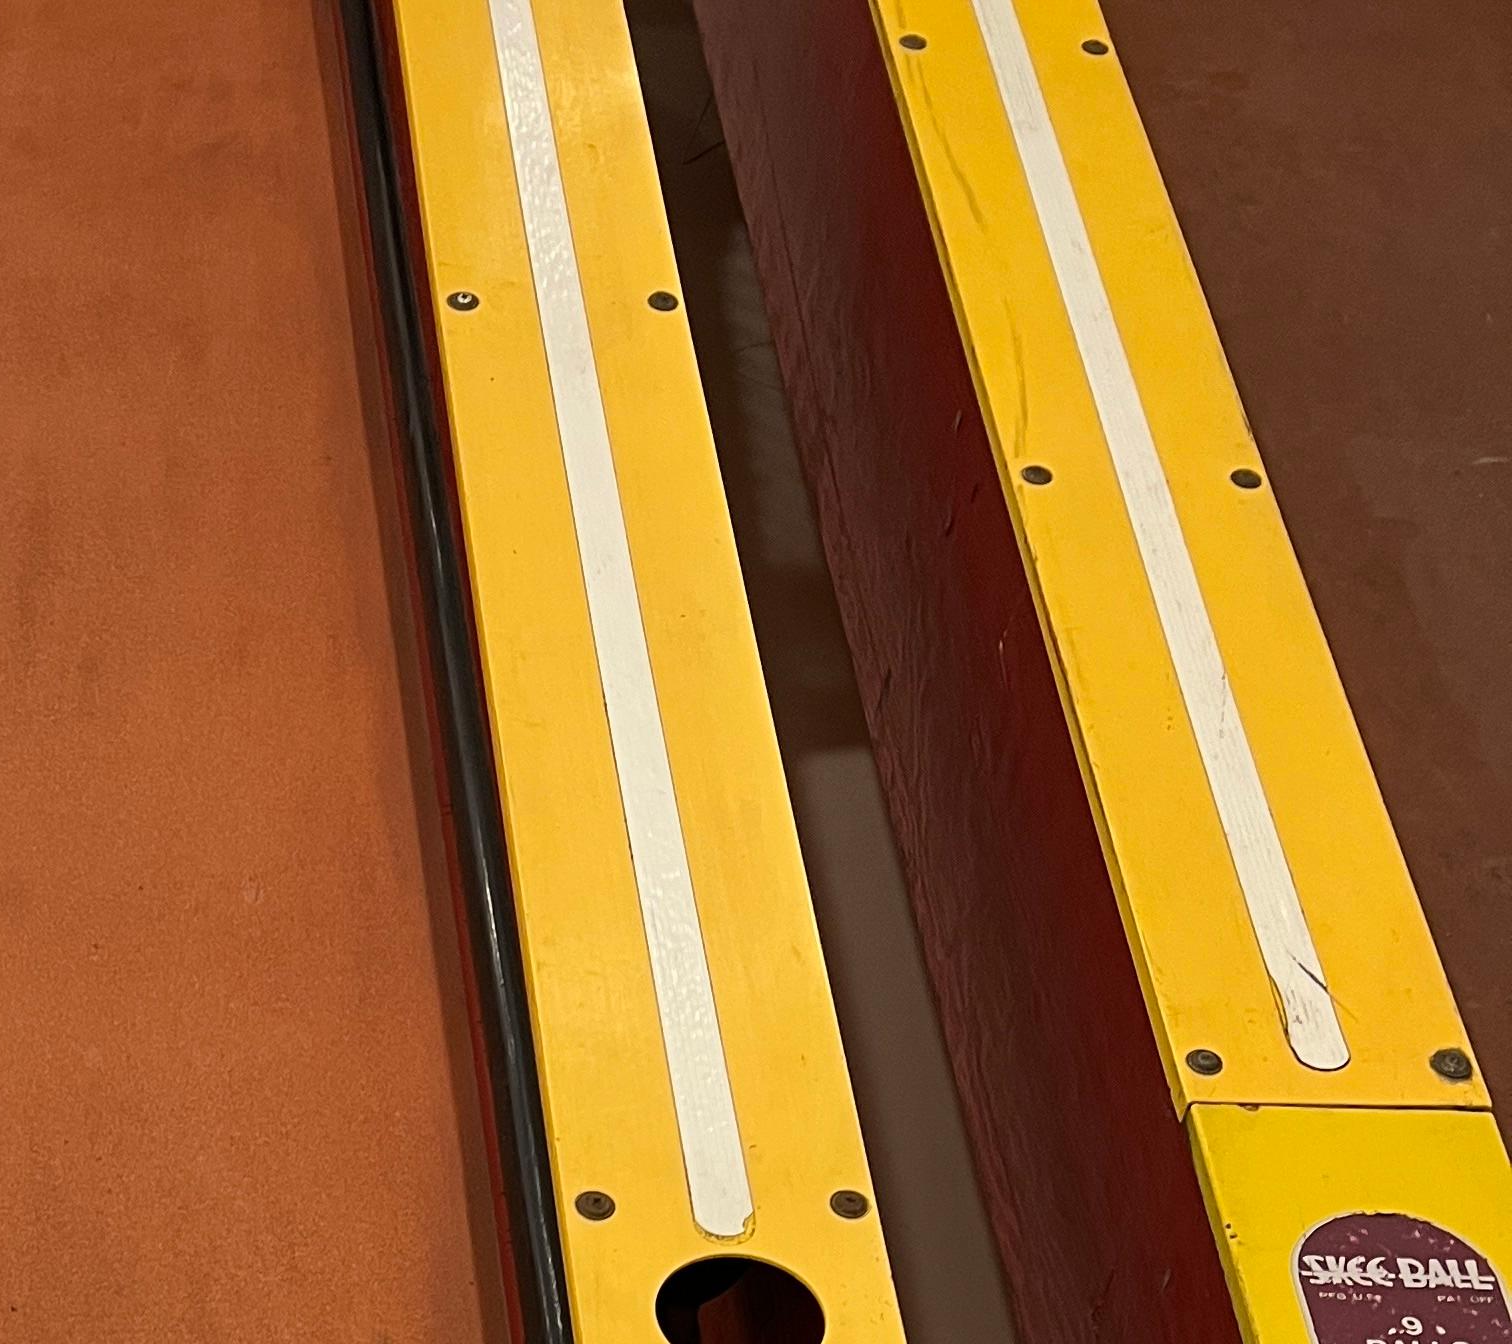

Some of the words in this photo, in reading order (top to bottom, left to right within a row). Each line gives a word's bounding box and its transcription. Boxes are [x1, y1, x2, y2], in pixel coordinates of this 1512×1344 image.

[1300, 1255, 1396, 1288] SKEE
[1397, 1257, 1495, 1290] BALL
[1401, 1316, 1423, 1336] 9
